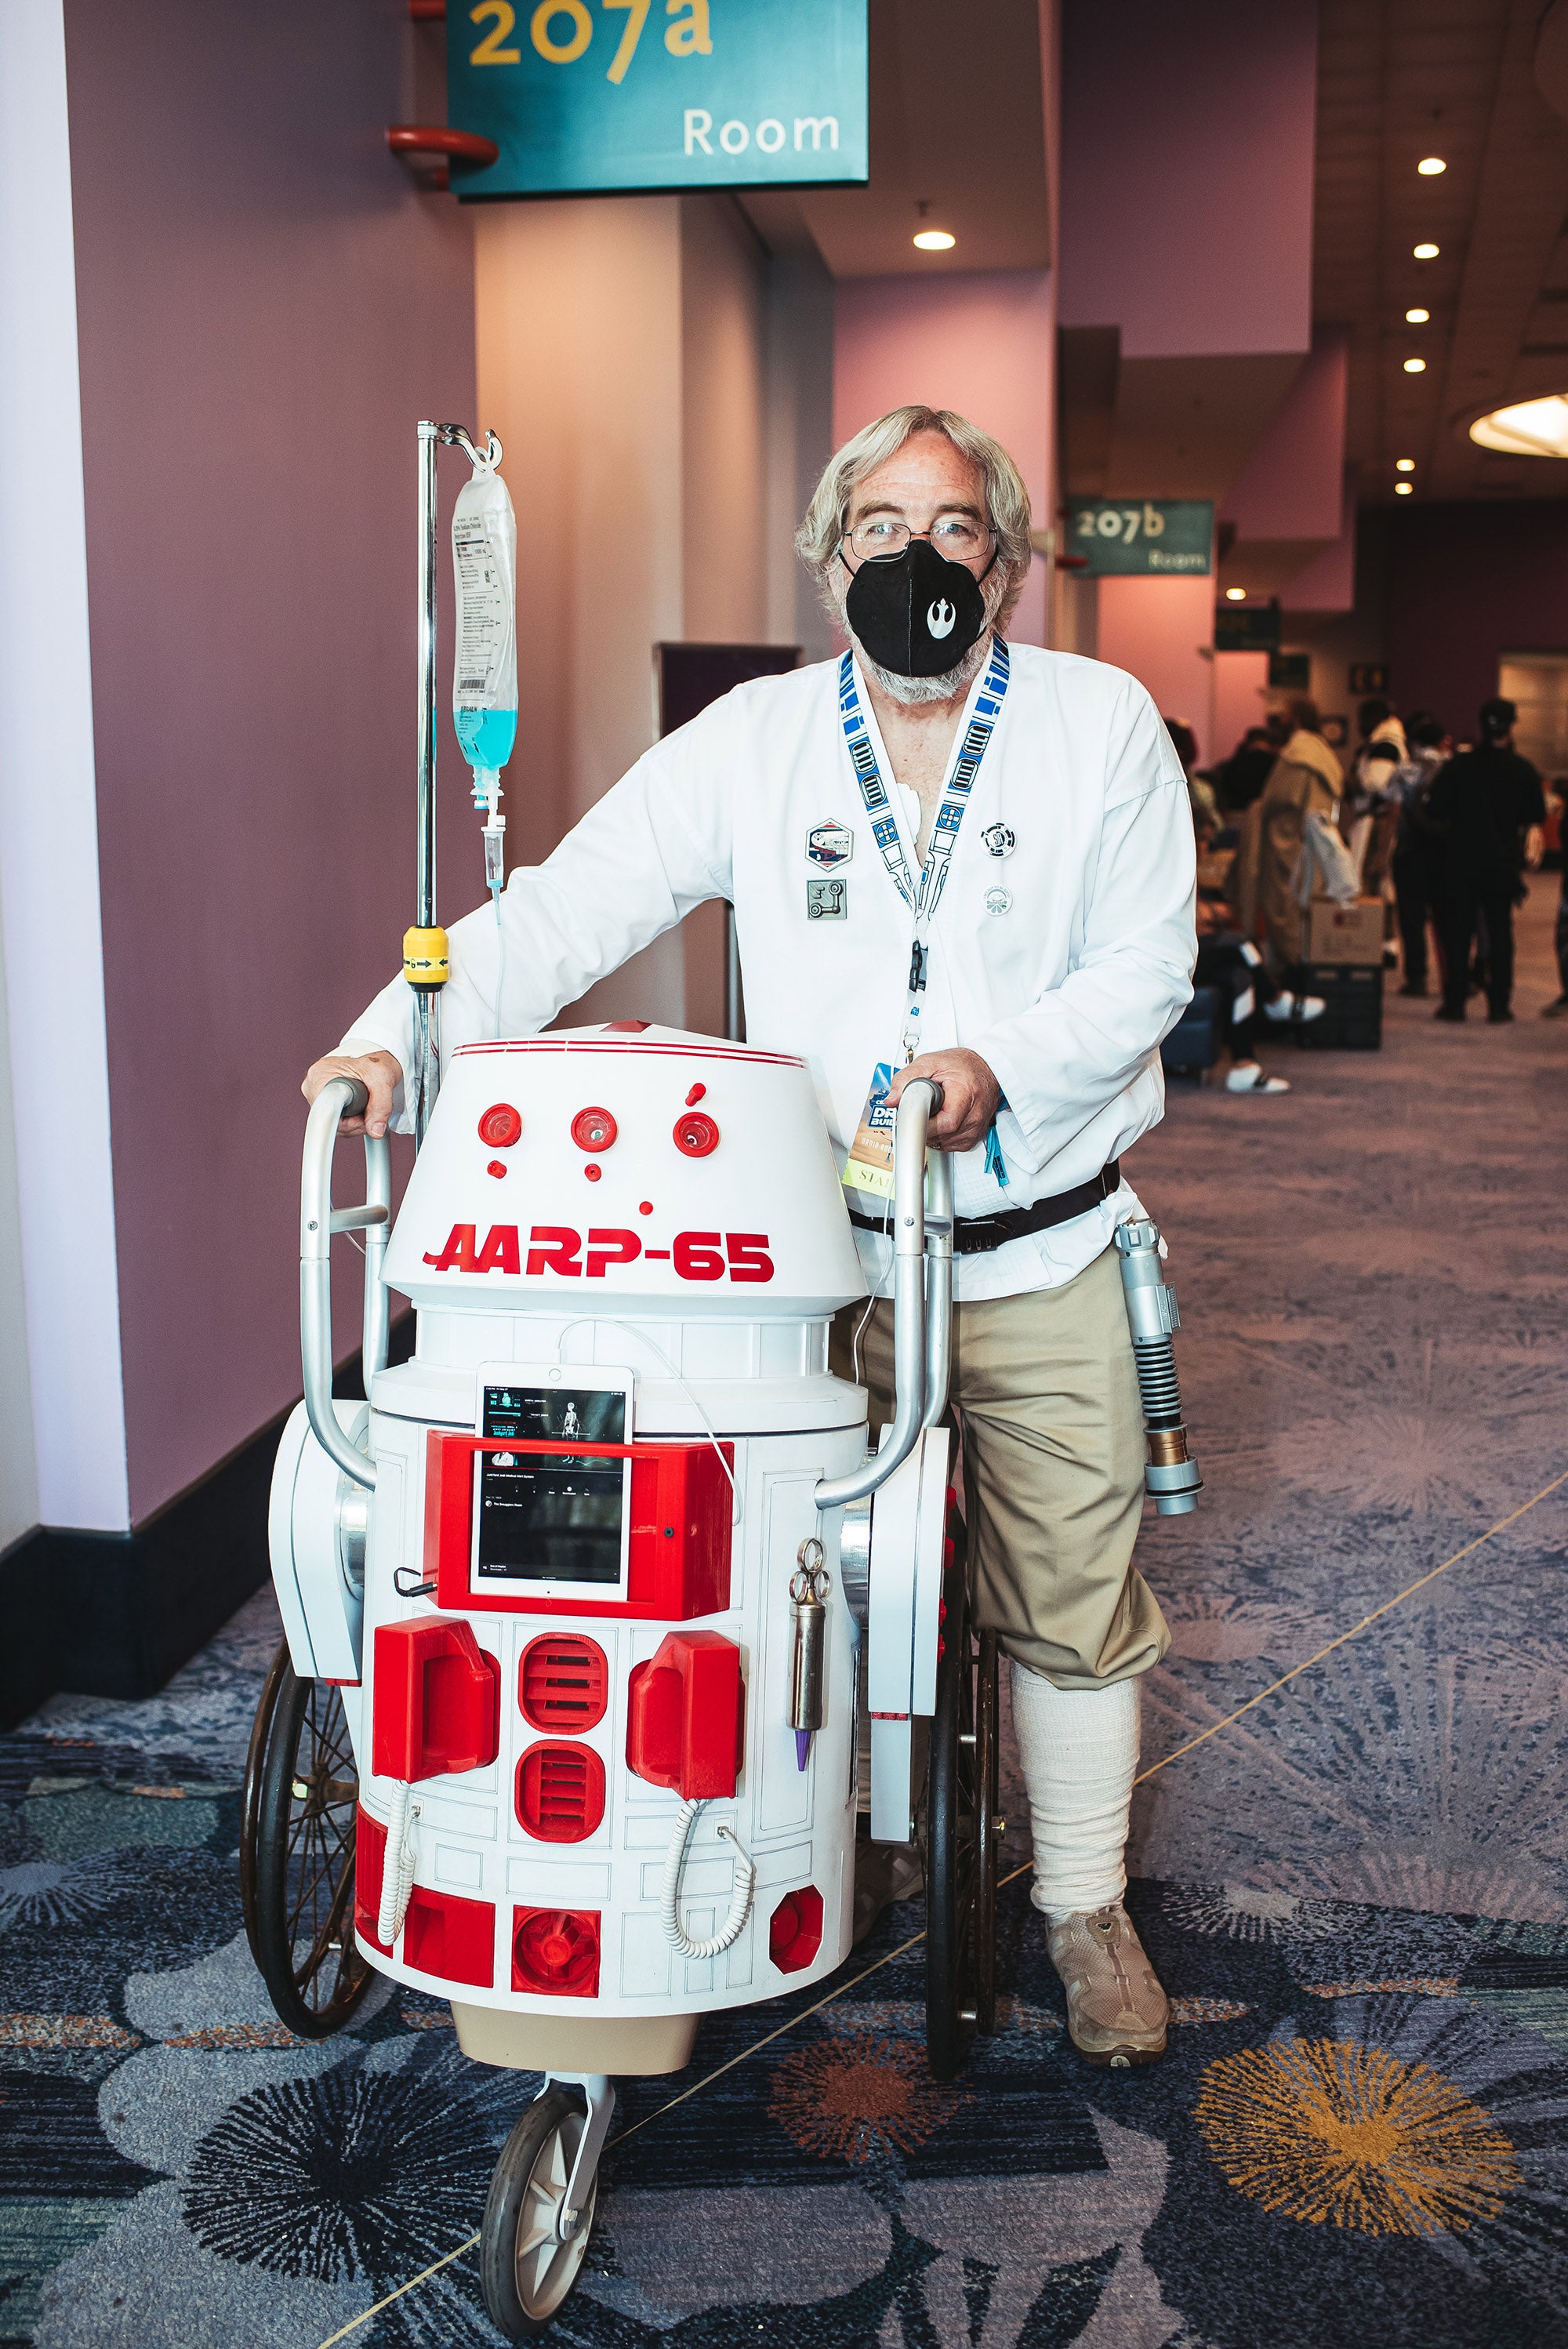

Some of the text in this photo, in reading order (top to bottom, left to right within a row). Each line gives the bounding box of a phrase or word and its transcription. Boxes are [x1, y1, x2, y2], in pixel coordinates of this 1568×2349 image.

[470, 0, 713, 85] 207a
[684, 108, 840, 156] Room
[1076, 501, 1166, 545] 207b
[870, 1118, 893, 1127] BUIL
[873, 1107, 897, 1119] DR
[422, 1223, 775, 1283] AARP-65
